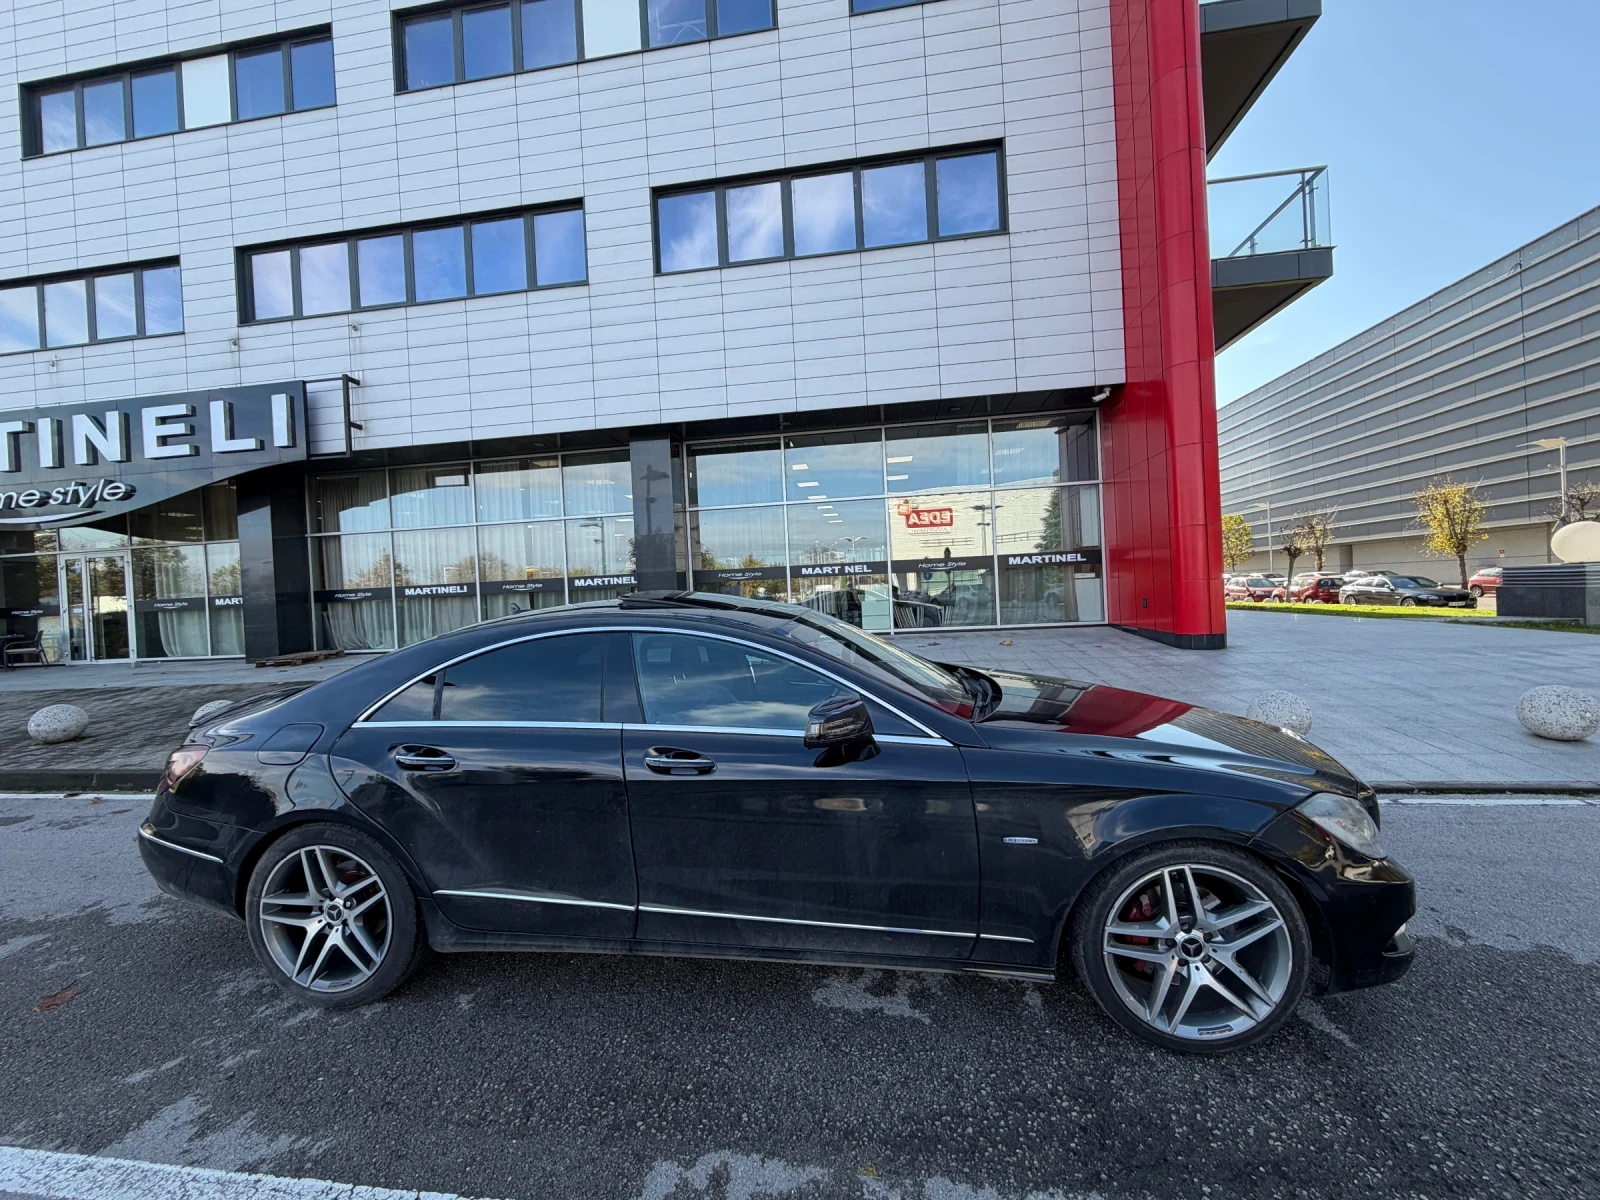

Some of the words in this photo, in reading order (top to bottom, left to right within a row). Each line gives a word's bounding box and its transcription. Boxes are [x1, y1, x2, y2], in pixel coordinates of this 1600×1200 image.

[49, 478, 127, 508] style
[1008, 553, 1087, 565] MARTINEL
[946, 561, 967, 569] Style
[744, 571, 762, 579] Style
[404, 585, 468, 596] MARTINELI
[526, 582, 543, 590] Style
